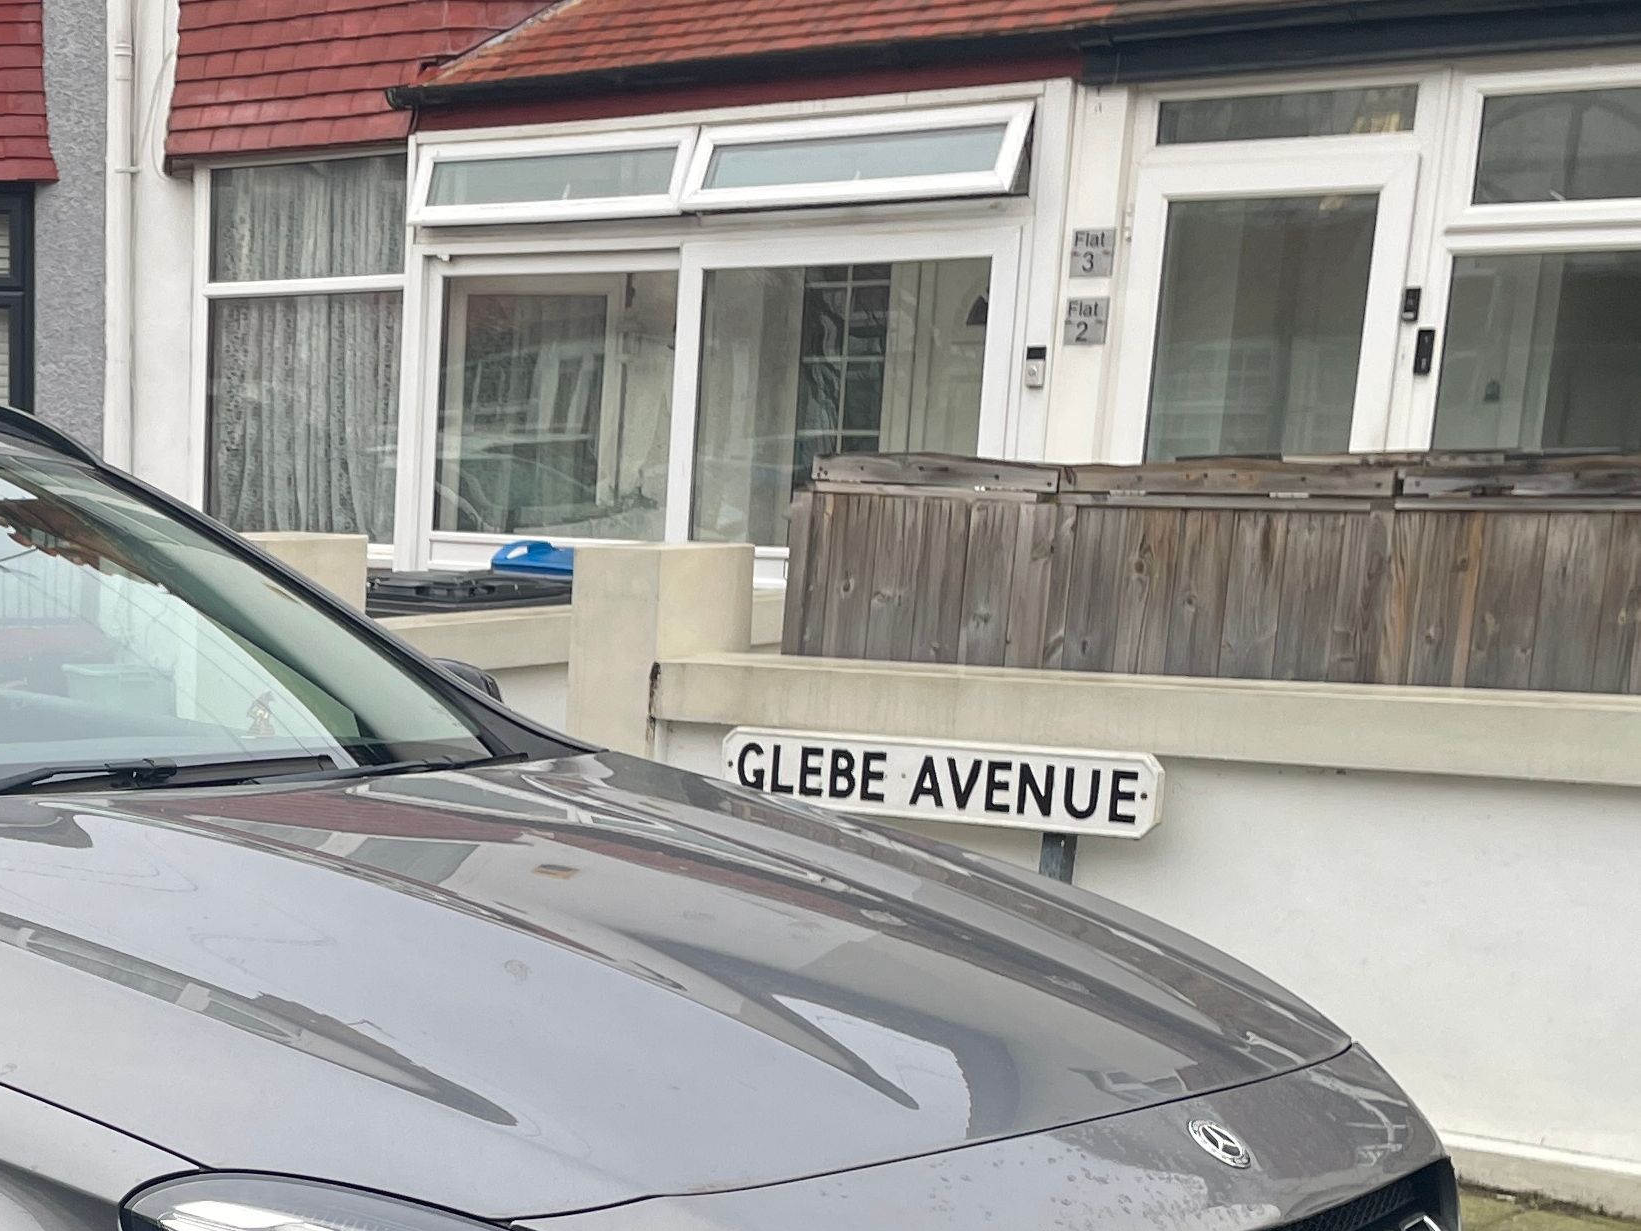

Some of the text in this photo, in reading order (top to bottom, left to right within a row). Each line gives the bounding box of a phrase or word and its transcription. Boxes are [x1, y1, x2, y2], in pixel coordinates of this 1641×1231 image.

[1075, 231, 1106, 248] Flat
[1082, 251, 1094, 273] 3
[1068, 301, 1100, 318] Flat
[1075, 321, 1088, 343] 2
[737, 742, 1140, 825] GLEBE AVENUE
